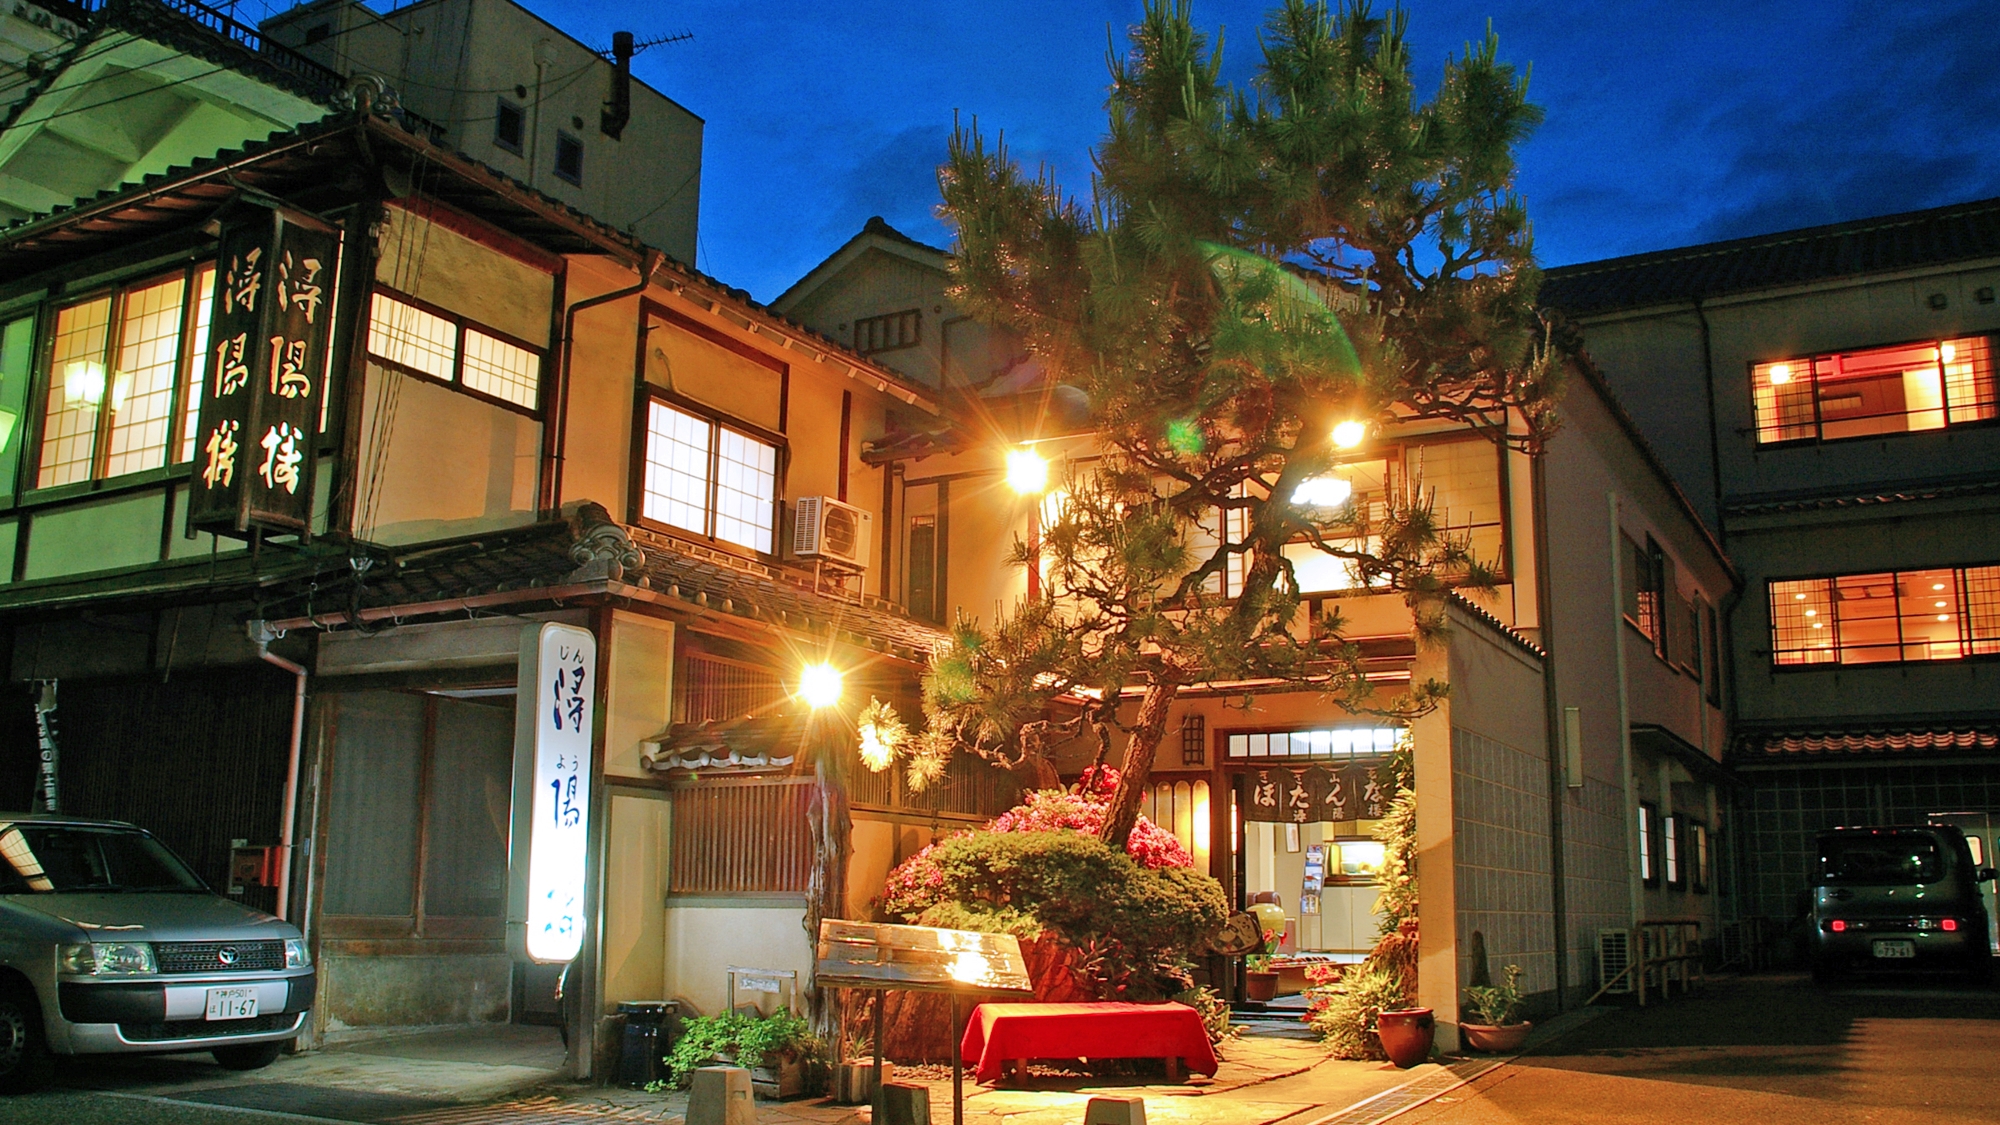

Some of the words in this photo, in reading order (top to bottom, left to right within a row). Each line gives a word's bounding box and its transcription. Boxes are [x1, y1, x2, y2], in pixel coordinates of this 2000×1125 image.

[560, 645, 584, 664] じん
[556, 754, 579, 772] よう
[219, 999, 256, 1017] 11-67
